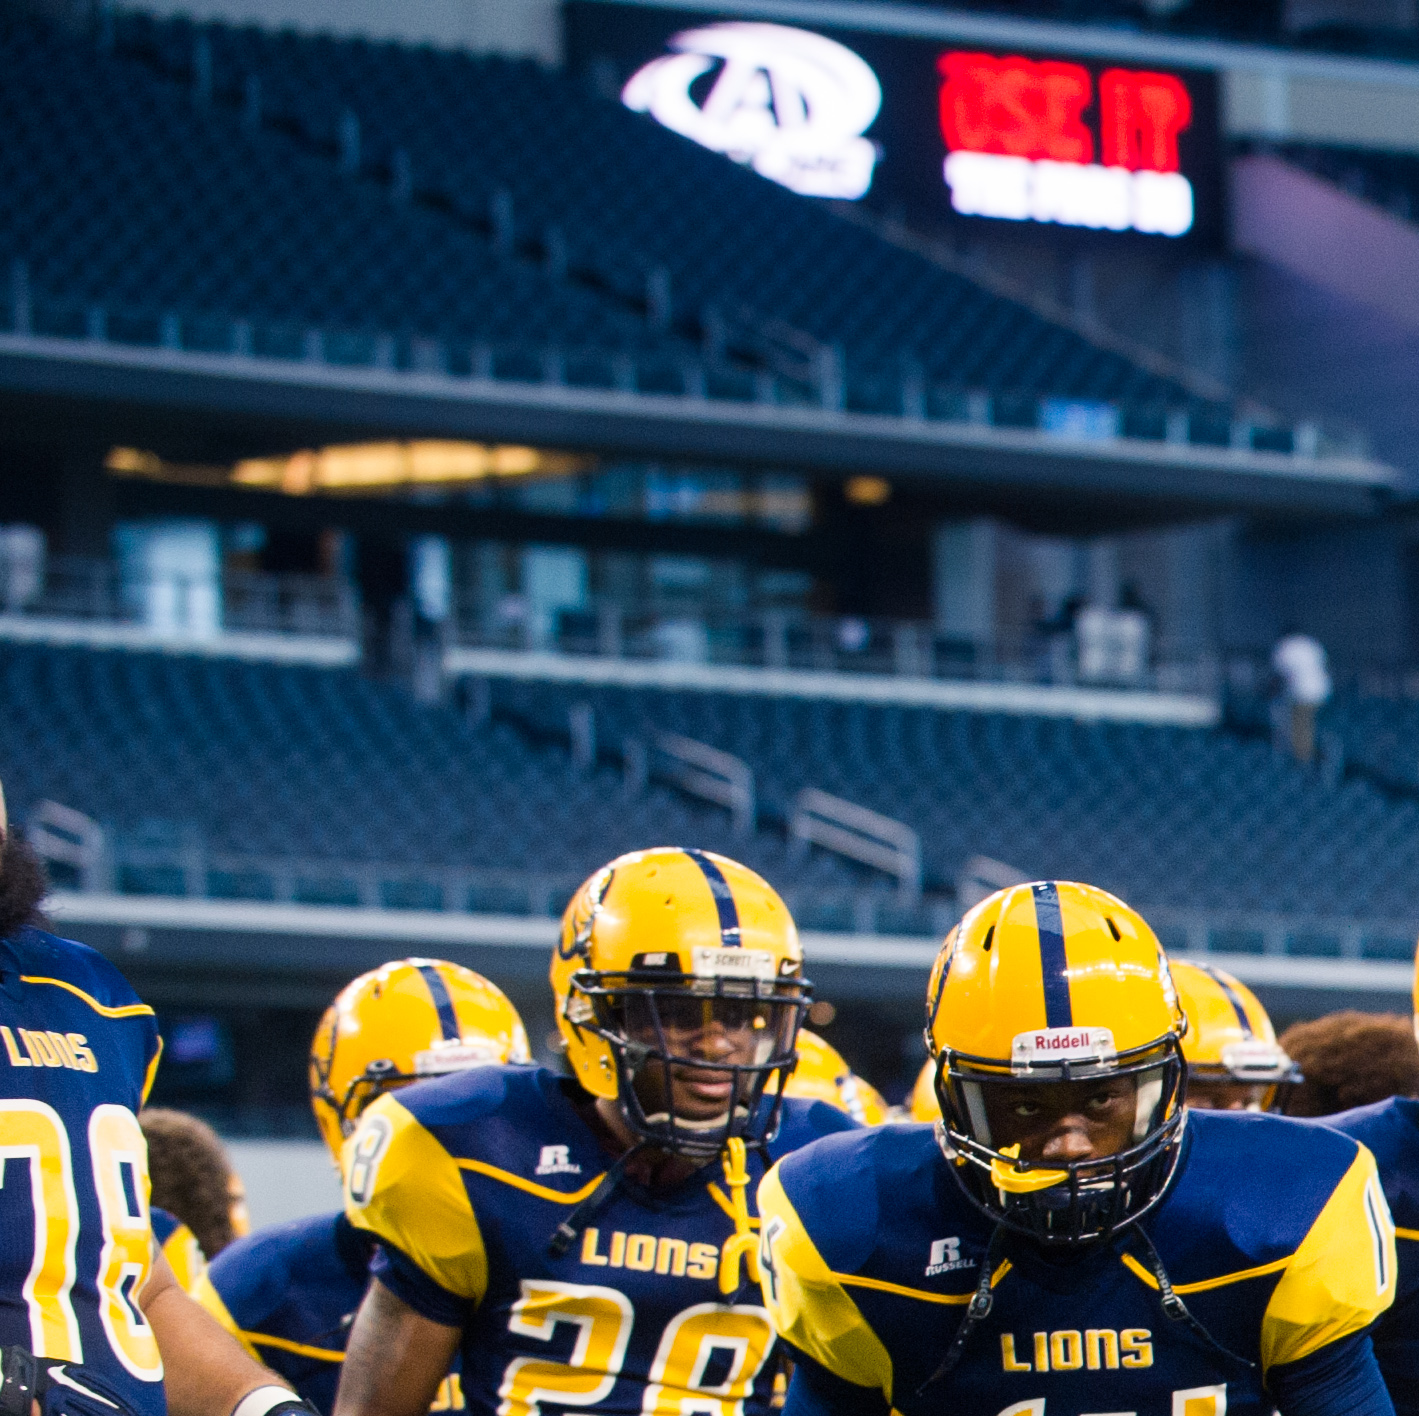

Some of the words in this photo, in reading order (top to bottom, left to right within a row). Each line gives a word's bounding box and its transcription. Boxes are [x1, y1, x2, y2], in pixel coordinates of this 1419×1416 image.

[0, 1026, 98, 1073] LIONS
[1035, 1032, 1090, 1050] Riddell
[0, 1099, 164, 1382] 78
[580, 1227, 720, 1280] LIONS
[925, 1257, 977, 1277] RUSSELL
[1000, 1328, 1154, 1373] LIONS
